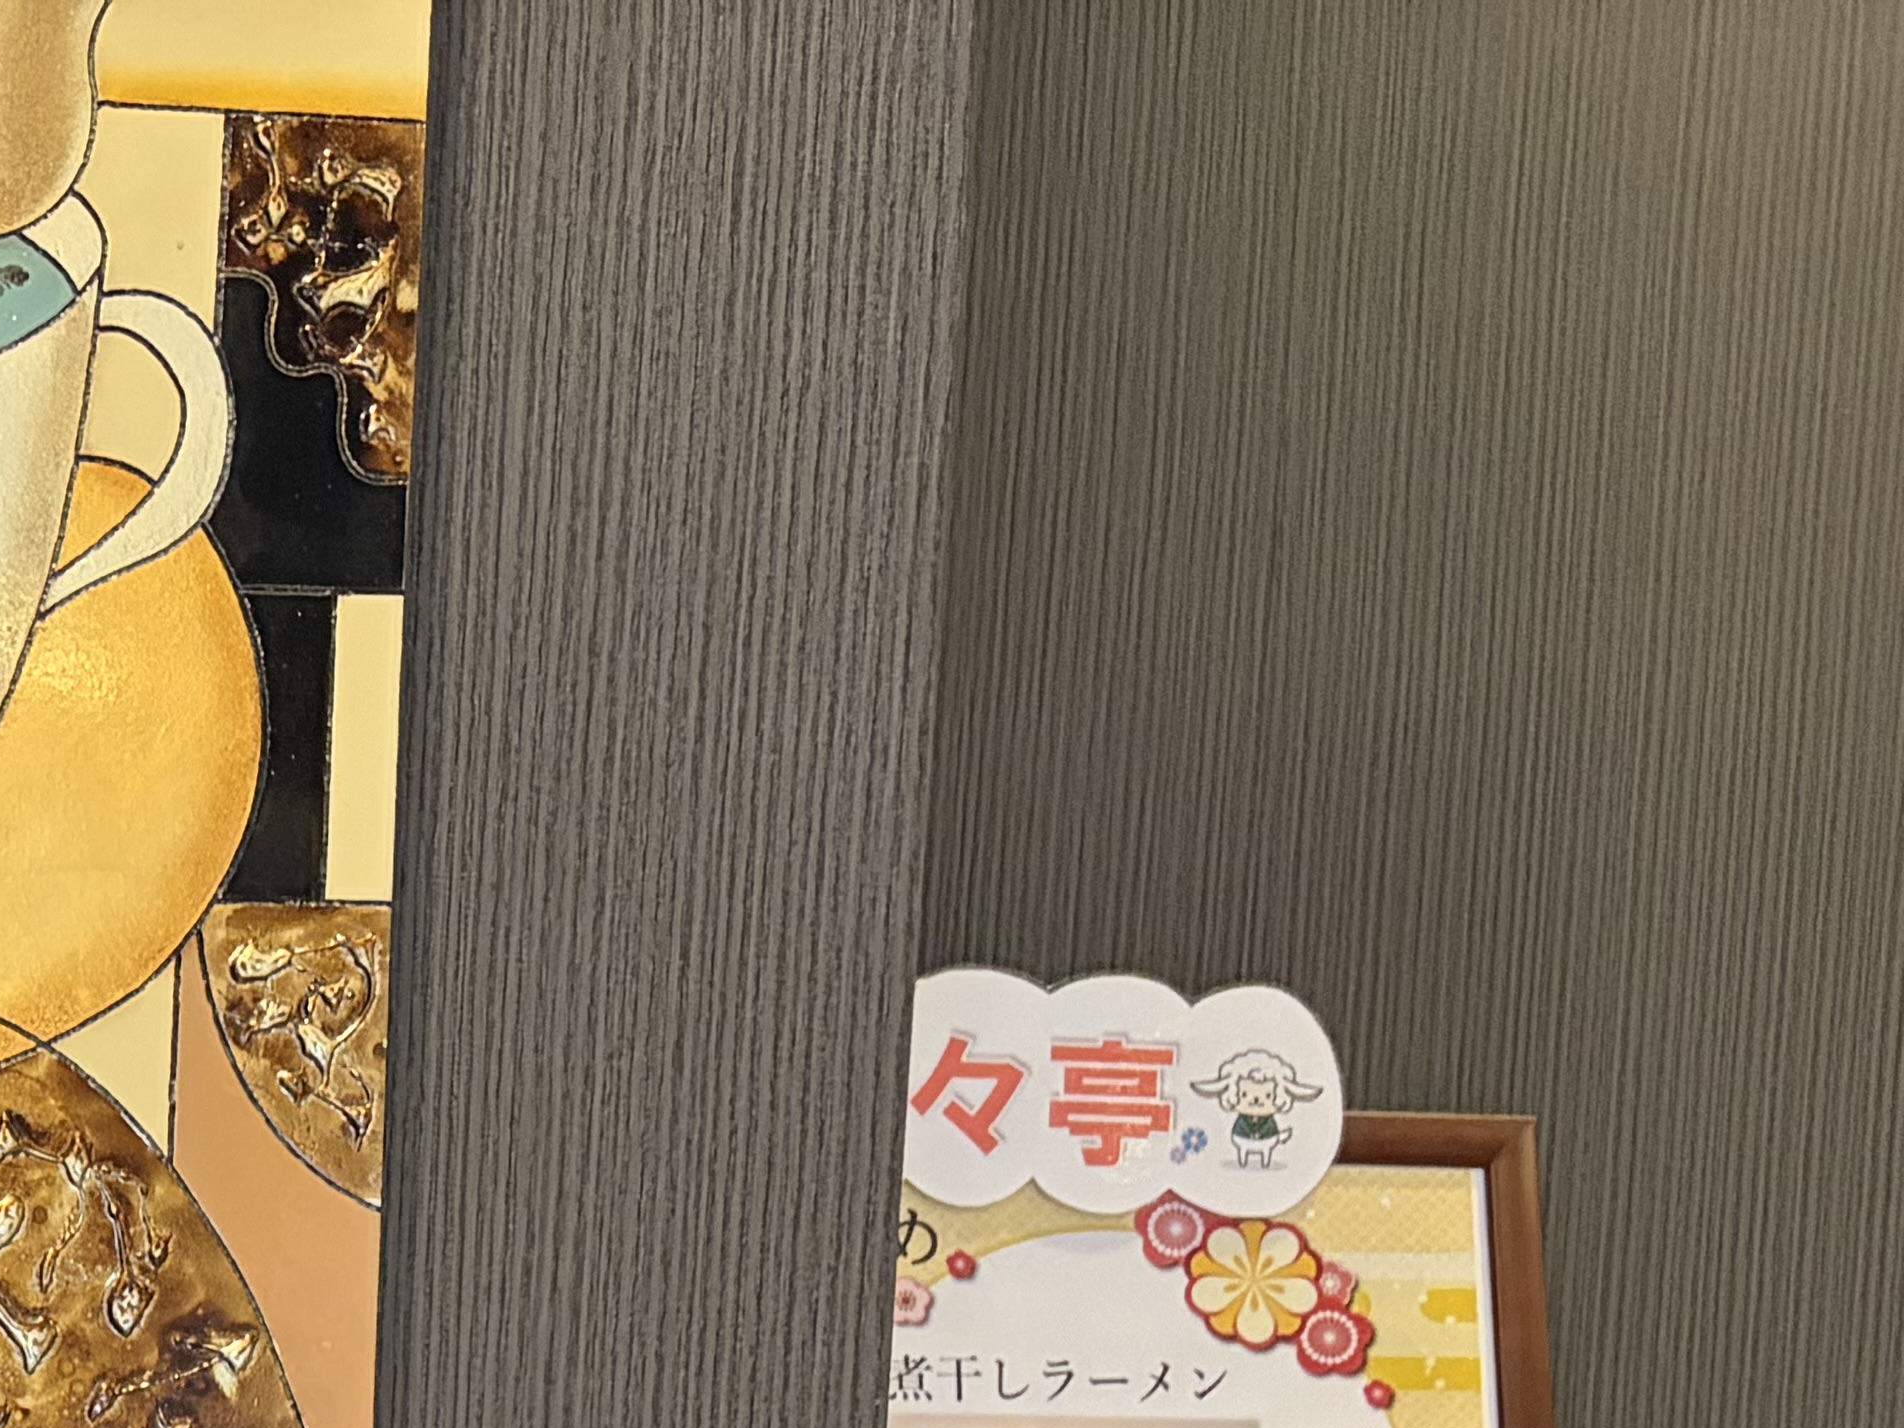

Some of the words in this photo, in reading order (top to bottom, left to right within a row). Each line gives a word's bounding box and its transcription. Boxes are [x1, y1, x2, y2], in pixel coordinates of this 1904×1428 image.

[890, 1354, 1228, 1403] 煮干しラーメン
